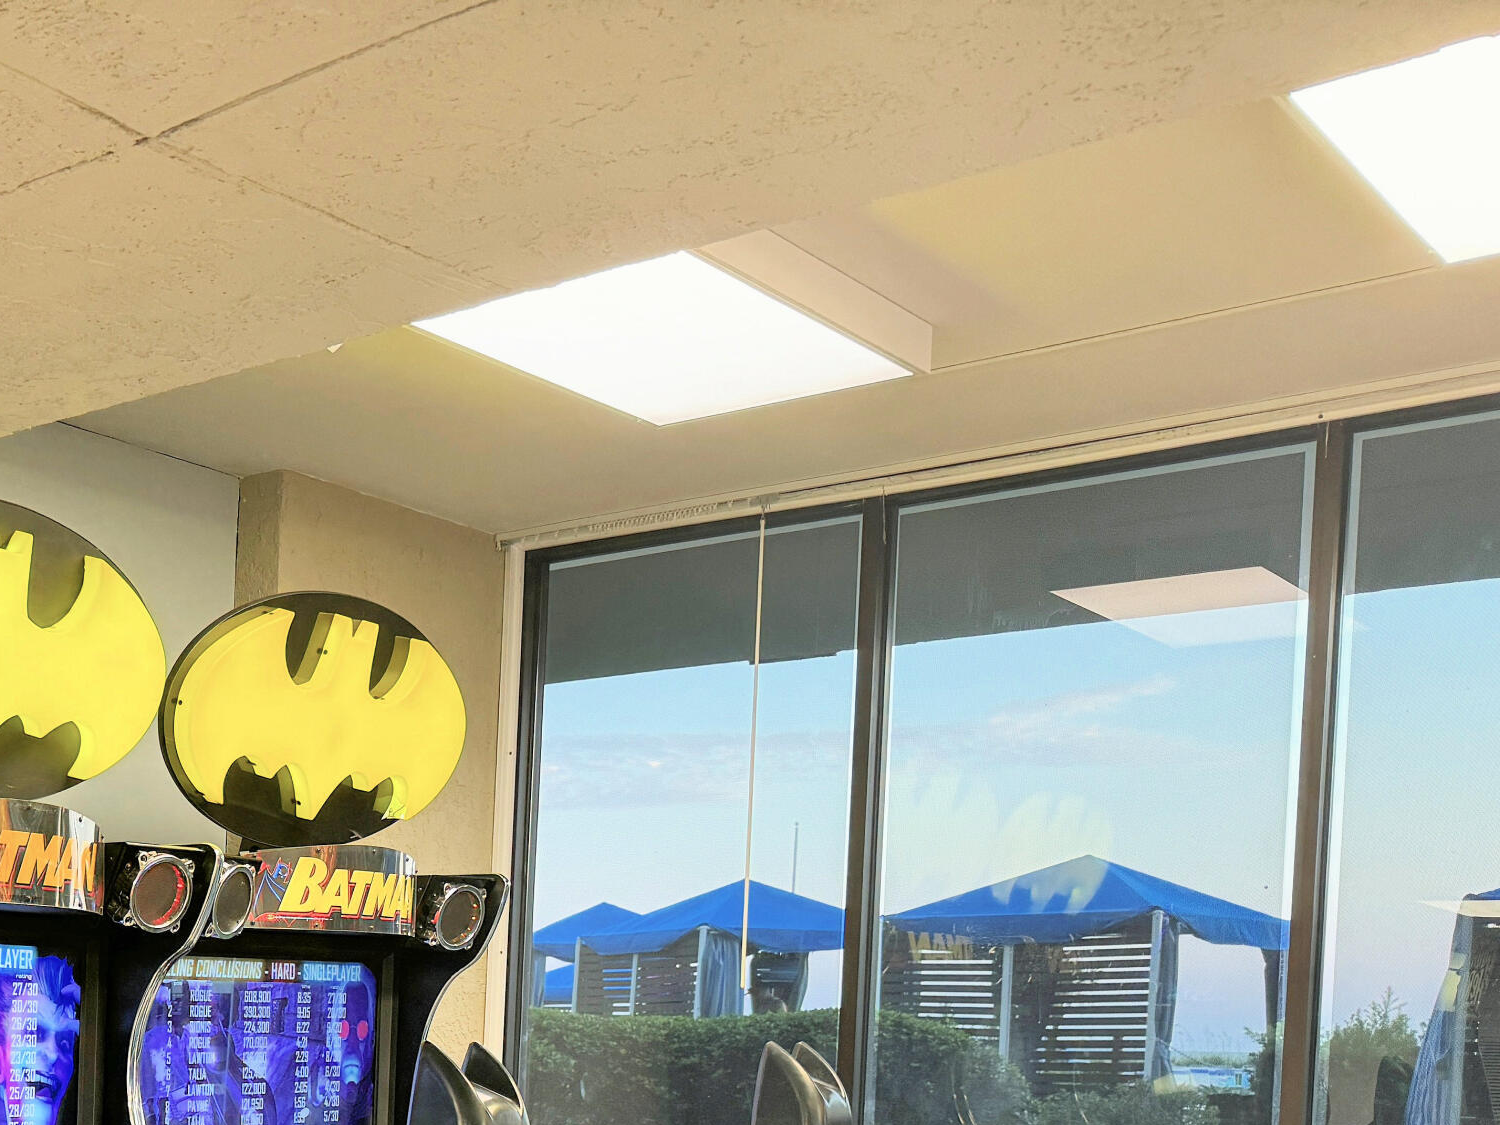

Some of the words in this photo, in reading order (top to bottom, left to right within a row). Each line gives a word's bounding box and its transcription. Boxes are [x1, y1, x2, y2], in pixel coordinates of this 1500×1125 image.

[278, 856, 414, 920] BATMAN
[195, 959, 263, 979] CONCLUSIONS
[271, 962, 296, 980] HARD
[303, 963, 362, 981] SINGLEPLAYER
[12, 982, 39, 996] 27/30
[190, 990, 213, 1002] ROGUE
[297, 991, 311, 1004] 8:35
[11, 999, 38, 1014] 30/30
[167, 1005, 173, 1018] 2
[189, 1005, 212, 1018] ROGUE
[296, 1006, 311, 1019] 9:05
[167, 1020, 173, 1033] 3
[243, 1021, 270, 1033] 224,300
[296, 1021, 310, 1033] 6:22
[10, 1034, 37, 1048] 23/30
[167, 1036, 172, 1049] 4
[188, 1036, 212, 1049] ROGUE
[166, 1052, 172, 1065] 5
[188, 1051, 216, 1065] LAWTON
[295, 1051, 309, 1063] 2:29
[9, 1067, 36, 1083] 26/30
[166, 1068, 171, 1081] 6
[188, 1067, 207, 1081] TALIA
[294, 1065, 309, 1078] 4:00
[9, 1086, 36, 1101] 25/30
[187, 1083, 215, 1097] LAWTON
[294, 1081, 308, 1094] 2:05
[8, 1103, 35, 1118] 28/30
[165, 1100, 170, 1113] 8
[324, 1095, 340, 1107] 4/30
[323, 1110, 339, 1122] 5/30
